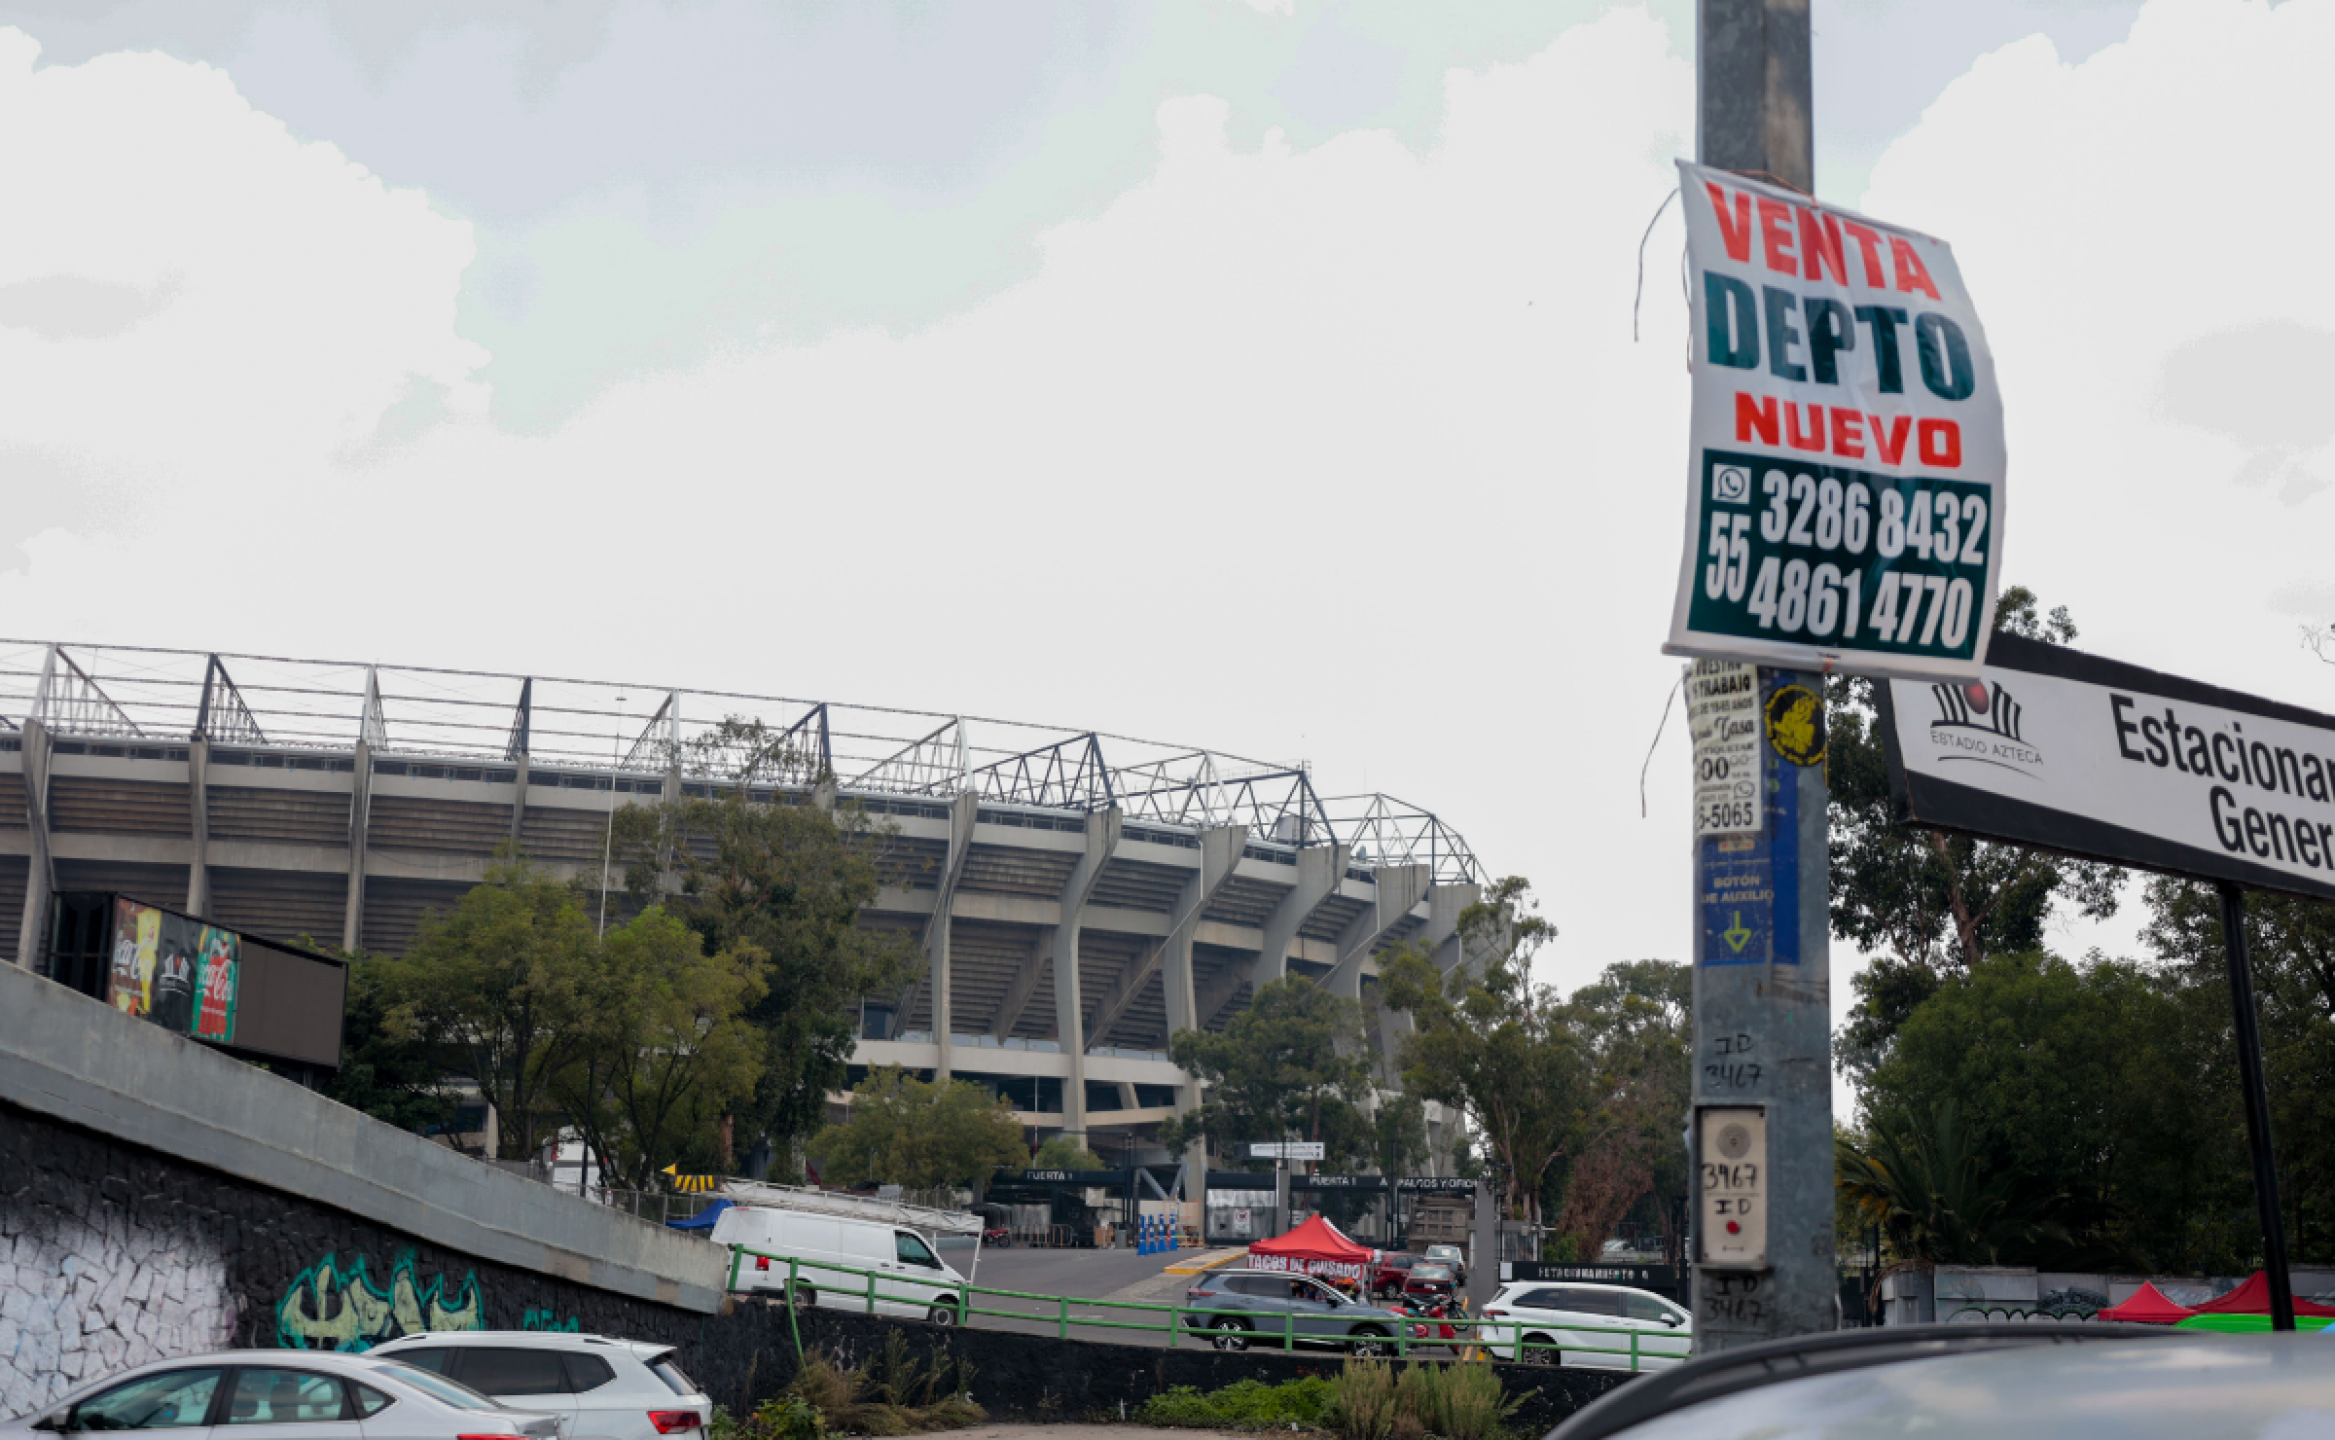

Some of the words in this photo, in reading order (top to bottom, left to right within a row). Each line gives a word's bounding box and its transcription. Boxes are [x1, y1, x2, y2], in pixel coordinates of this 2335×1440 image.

[1704, 180, 1942, 302] VENTA
[1703, 269, 1975, 402] DEPTO
[1735, 391, 1962, 468] NUEVO
[1706, 511, 1751, 602] 55
[1760, 469, 1870, 554] 3286
[1876, 488, 1988, 566] 8432
[1747, 556, 1862, 639] 4861
[1868, 571, 1974, 649] 4770
[1930, 729, 1988, 754] ESTADIO
[1992, 743, 2044, 766] AZTECA
[2209, 785, 2334, 871] Gener
[1712, 874, 1761, 888] BOTÓN
[1026, 1170, 1066, 1180] PUERTA
[1308, 1176, 1349, 1186] PUERTA
[1397, 1178, 1439, 1188] PALCOS
[1247, 1254, 1287, 1270] TACOS
[1290, 1256, 1304, 1272] DE
[1307, 1259, 1361, 1279] GUISADO
